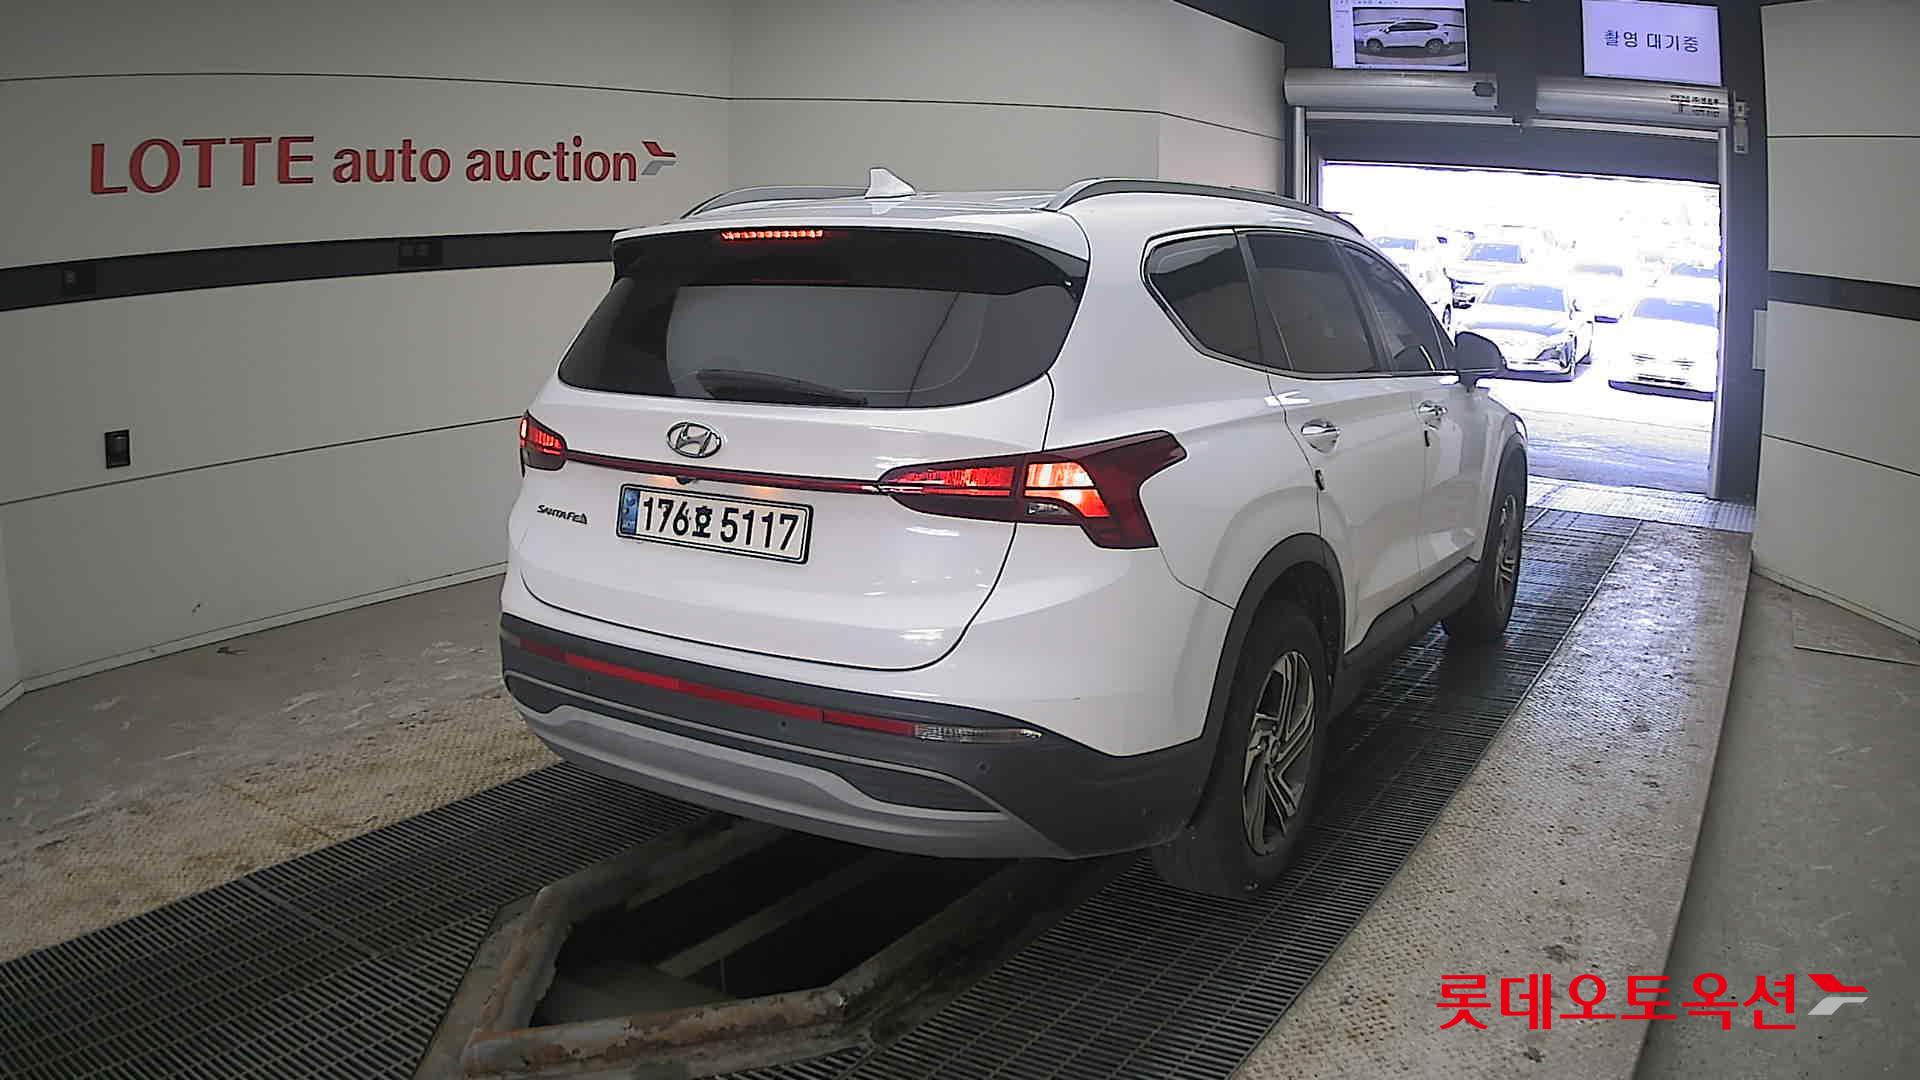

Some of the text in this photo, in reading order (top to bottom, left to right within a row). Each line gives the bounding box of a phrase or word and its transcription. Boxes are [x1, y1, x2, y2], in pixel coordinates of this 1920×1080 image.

[1604, 30, 1698, 53] 촬영 대기중
[90, 135, 638, 194] LOTTE auto auction
[720, 507, 799, 550] 5117
